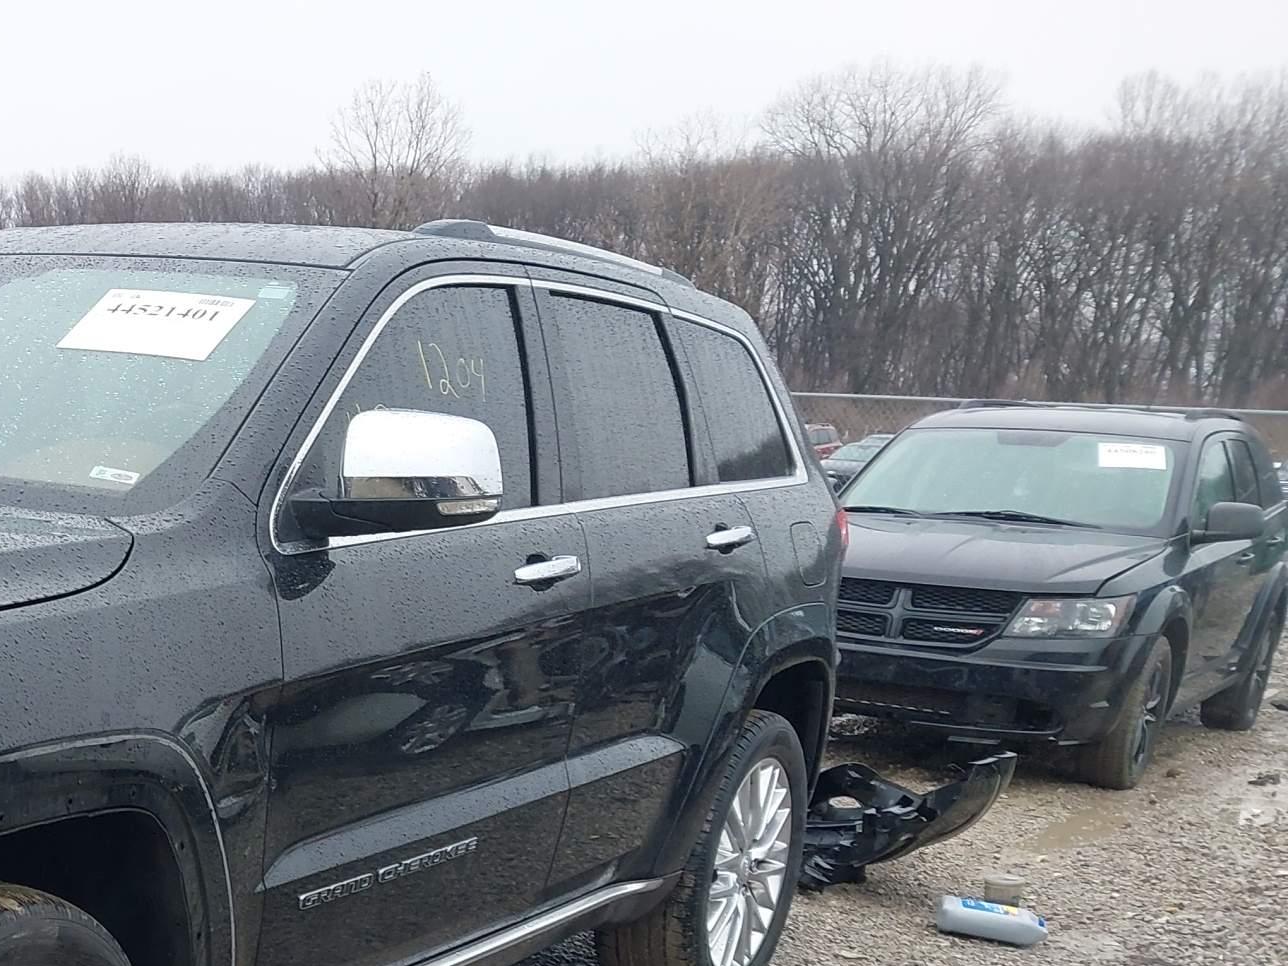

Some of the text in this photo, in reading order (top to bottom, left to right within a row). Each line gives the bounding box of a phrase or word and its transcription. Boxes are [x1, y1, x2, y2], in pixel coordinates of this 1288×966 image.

[106, 303, 220, 322] 44521401
[417, 340, 486, 402] 1204
[298, 836, 479, 910] GRAND CHEROKEE
